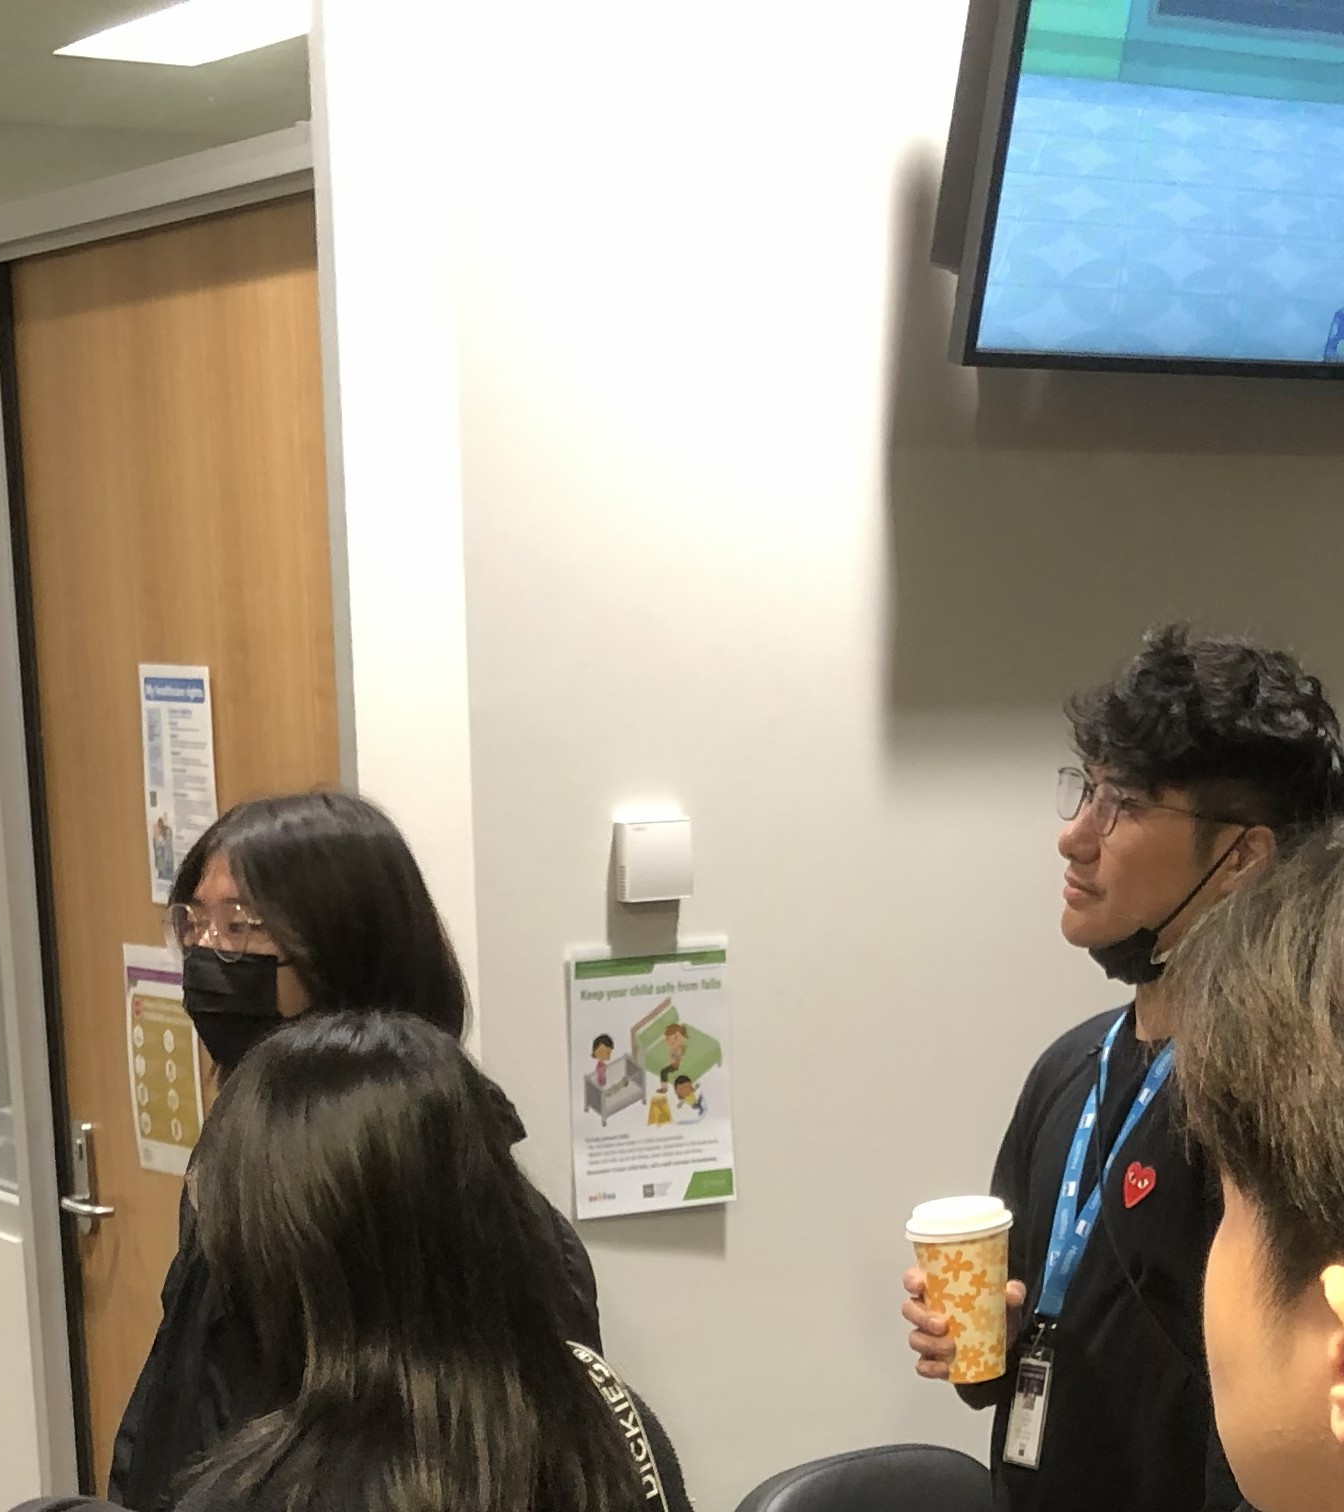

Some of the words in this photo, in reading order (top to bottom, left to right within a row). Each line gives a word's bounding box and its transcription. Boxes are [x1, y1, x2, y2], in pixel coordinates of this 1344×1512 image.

[580, 990, 605, 1001] Keep
[606, 989, 628, 1001] your
[629, 985, 654, 996] child
[656, 982, 675, 994] safe
[677, 981, 699, 992] from
[701, 978, 722, 990] falls
